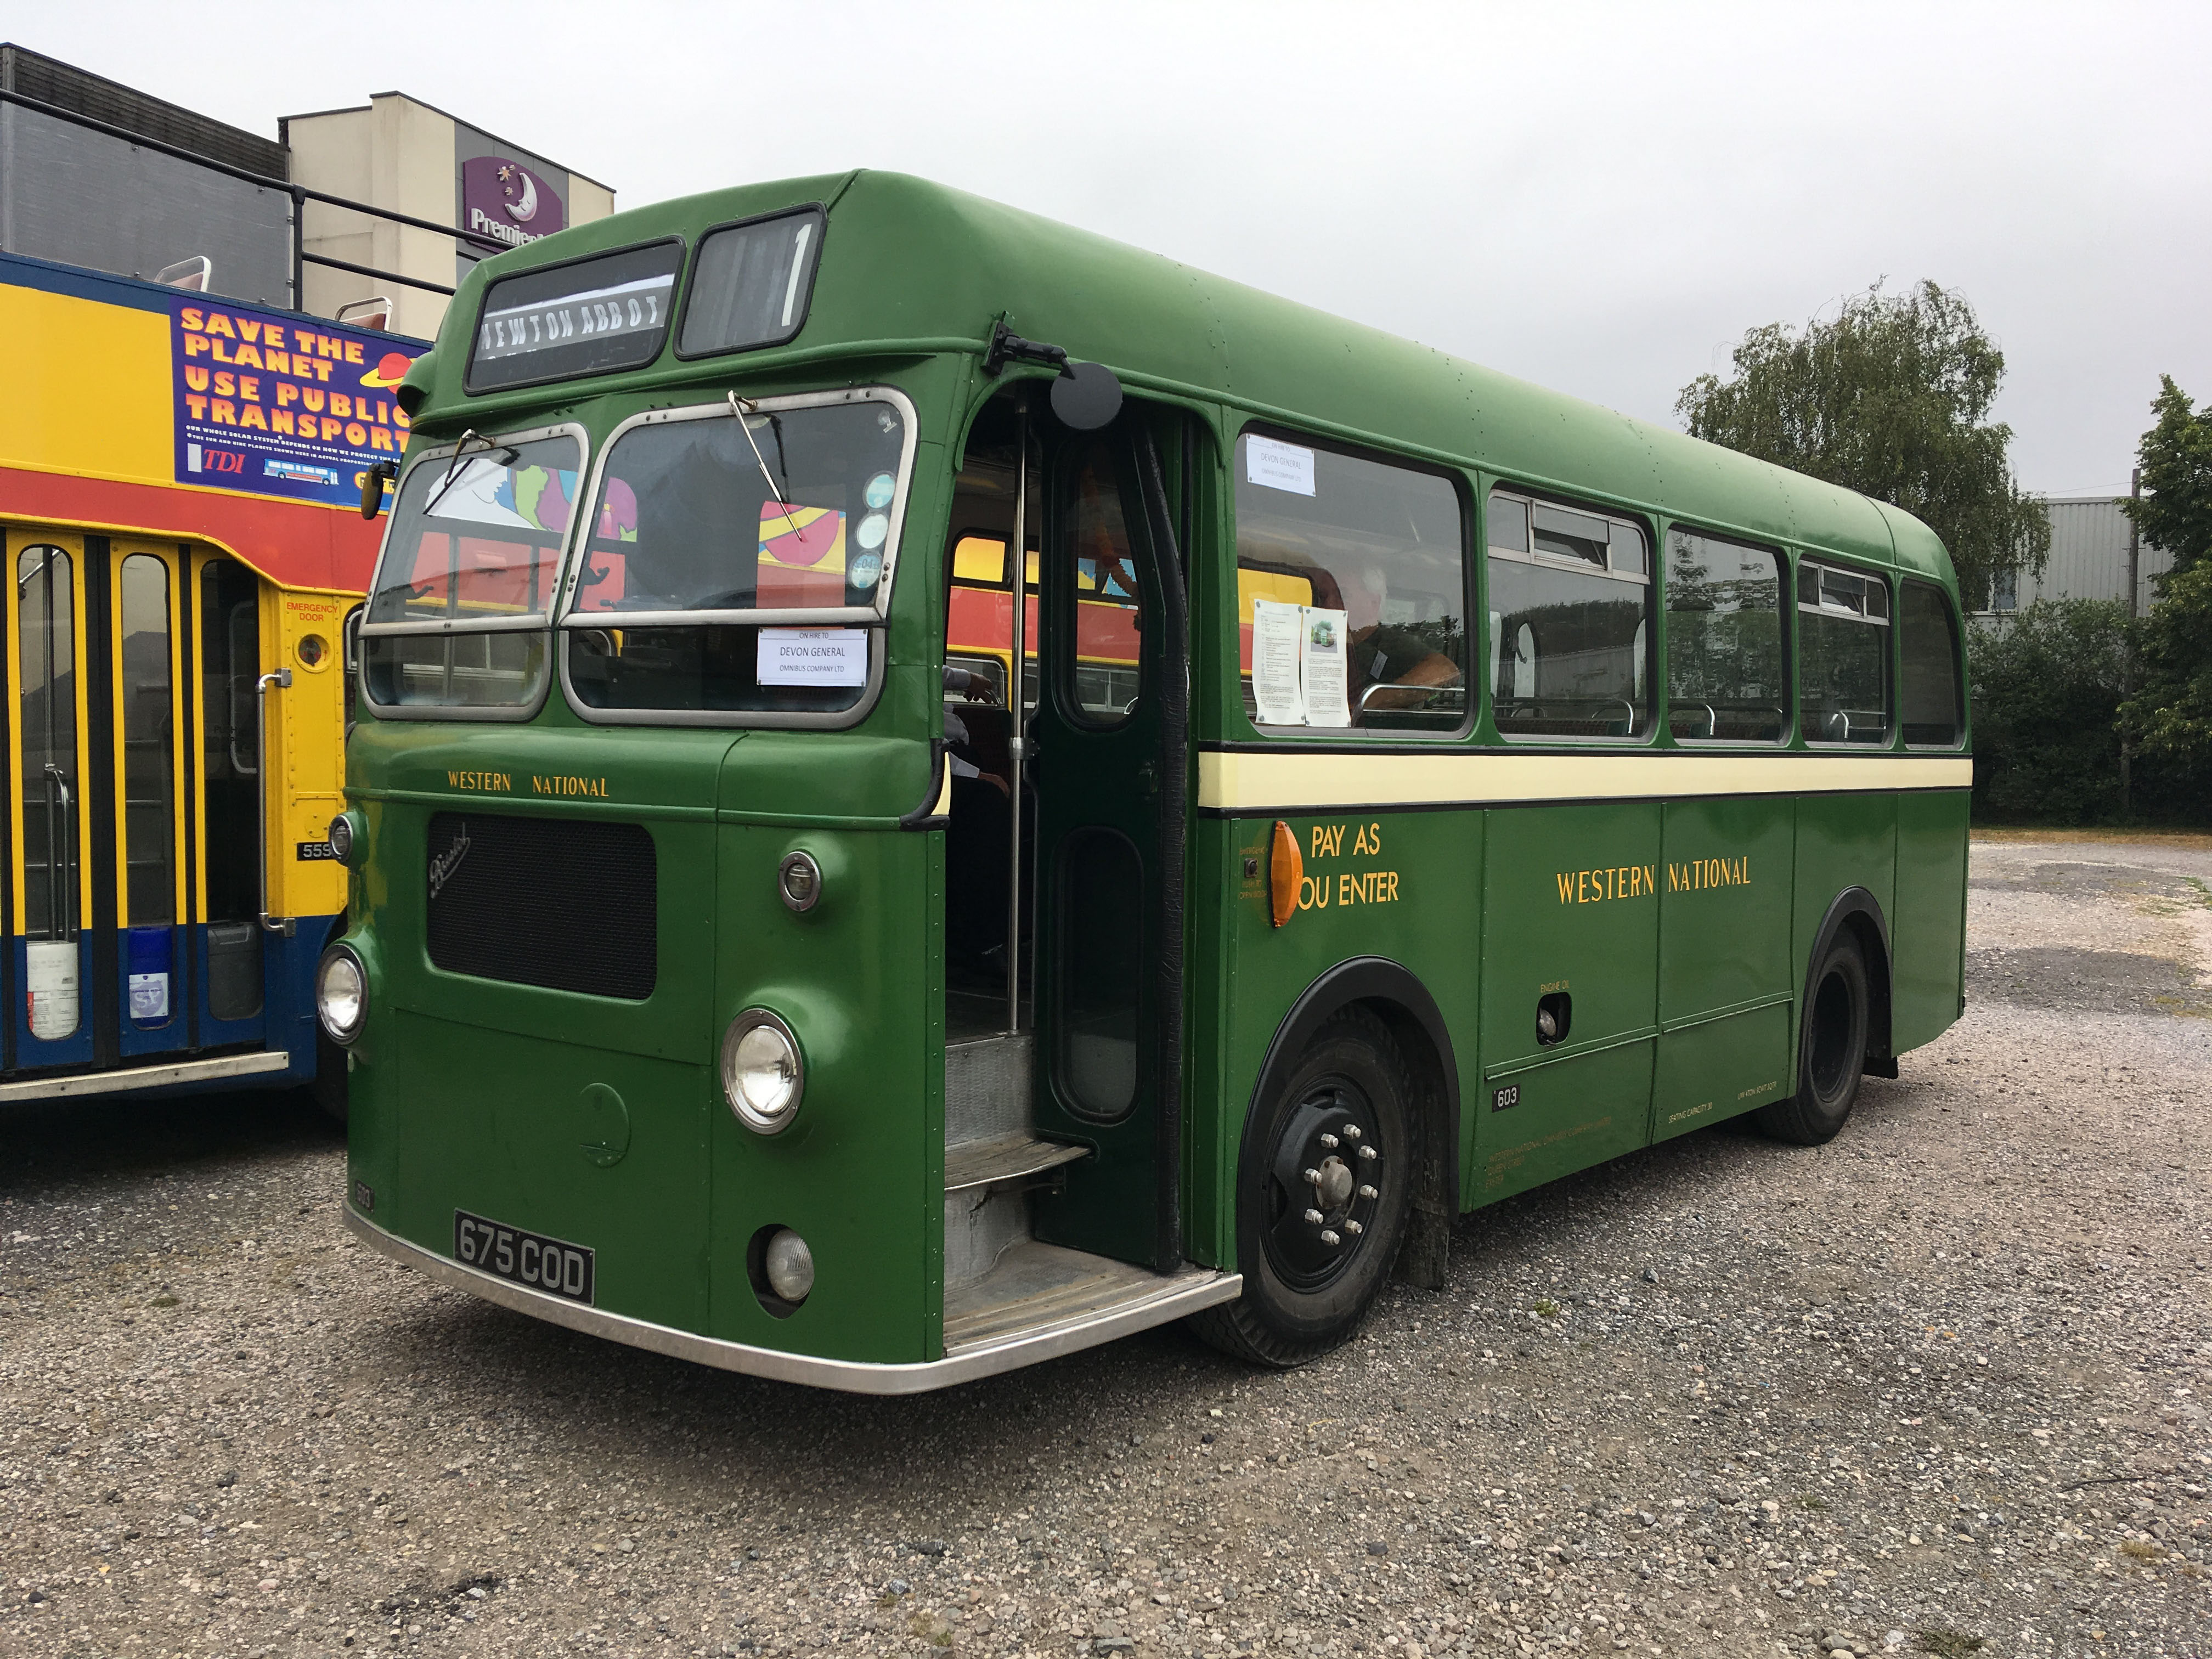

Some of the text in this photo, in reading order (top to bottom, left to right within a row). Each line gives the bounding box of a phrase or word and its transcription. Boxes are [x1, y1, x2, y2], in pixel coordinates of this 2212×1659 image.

[781, 223, 812, 326] 1
[180, 307, 364, 364] SAVE THE
[481, 295, 657, 350] NEWTON ABBOT
[184, 334, 333, 382] PLANET
[185, 364, 410, 428] USE PUBLIC
[185, 393, 410, 453] TRANSPORT
[202, 427, 227, 436] WHOLE
[229, 432, 252, 440] SOLAR
[281, 439, 311, 449] DEPENDS
[323, 447, 337, 455] HOW
[351, 452, 378, 460] PROTECT
[204, 449, 246, 474] TDI
[1261, 453, 1301, 469] DEVON GENERAL
[286, 602, 338, 613] EMERGENCY
[299, 613, 324, 622] DOOR
[780, 647, 845, 657] DEVON GENERAL
[448, 771, 609, 797] WESTERN NATIONAL
[1311, 823, 1380, 858] PAY AS
[1297, 871, 1398, 910] OU ENTER
[1556, 856, 1751, 905] WESTERN NATIONAL
[1497, 1087, 1517, 1107] 603
[460, 1218, 584, 1295] 675 COD
